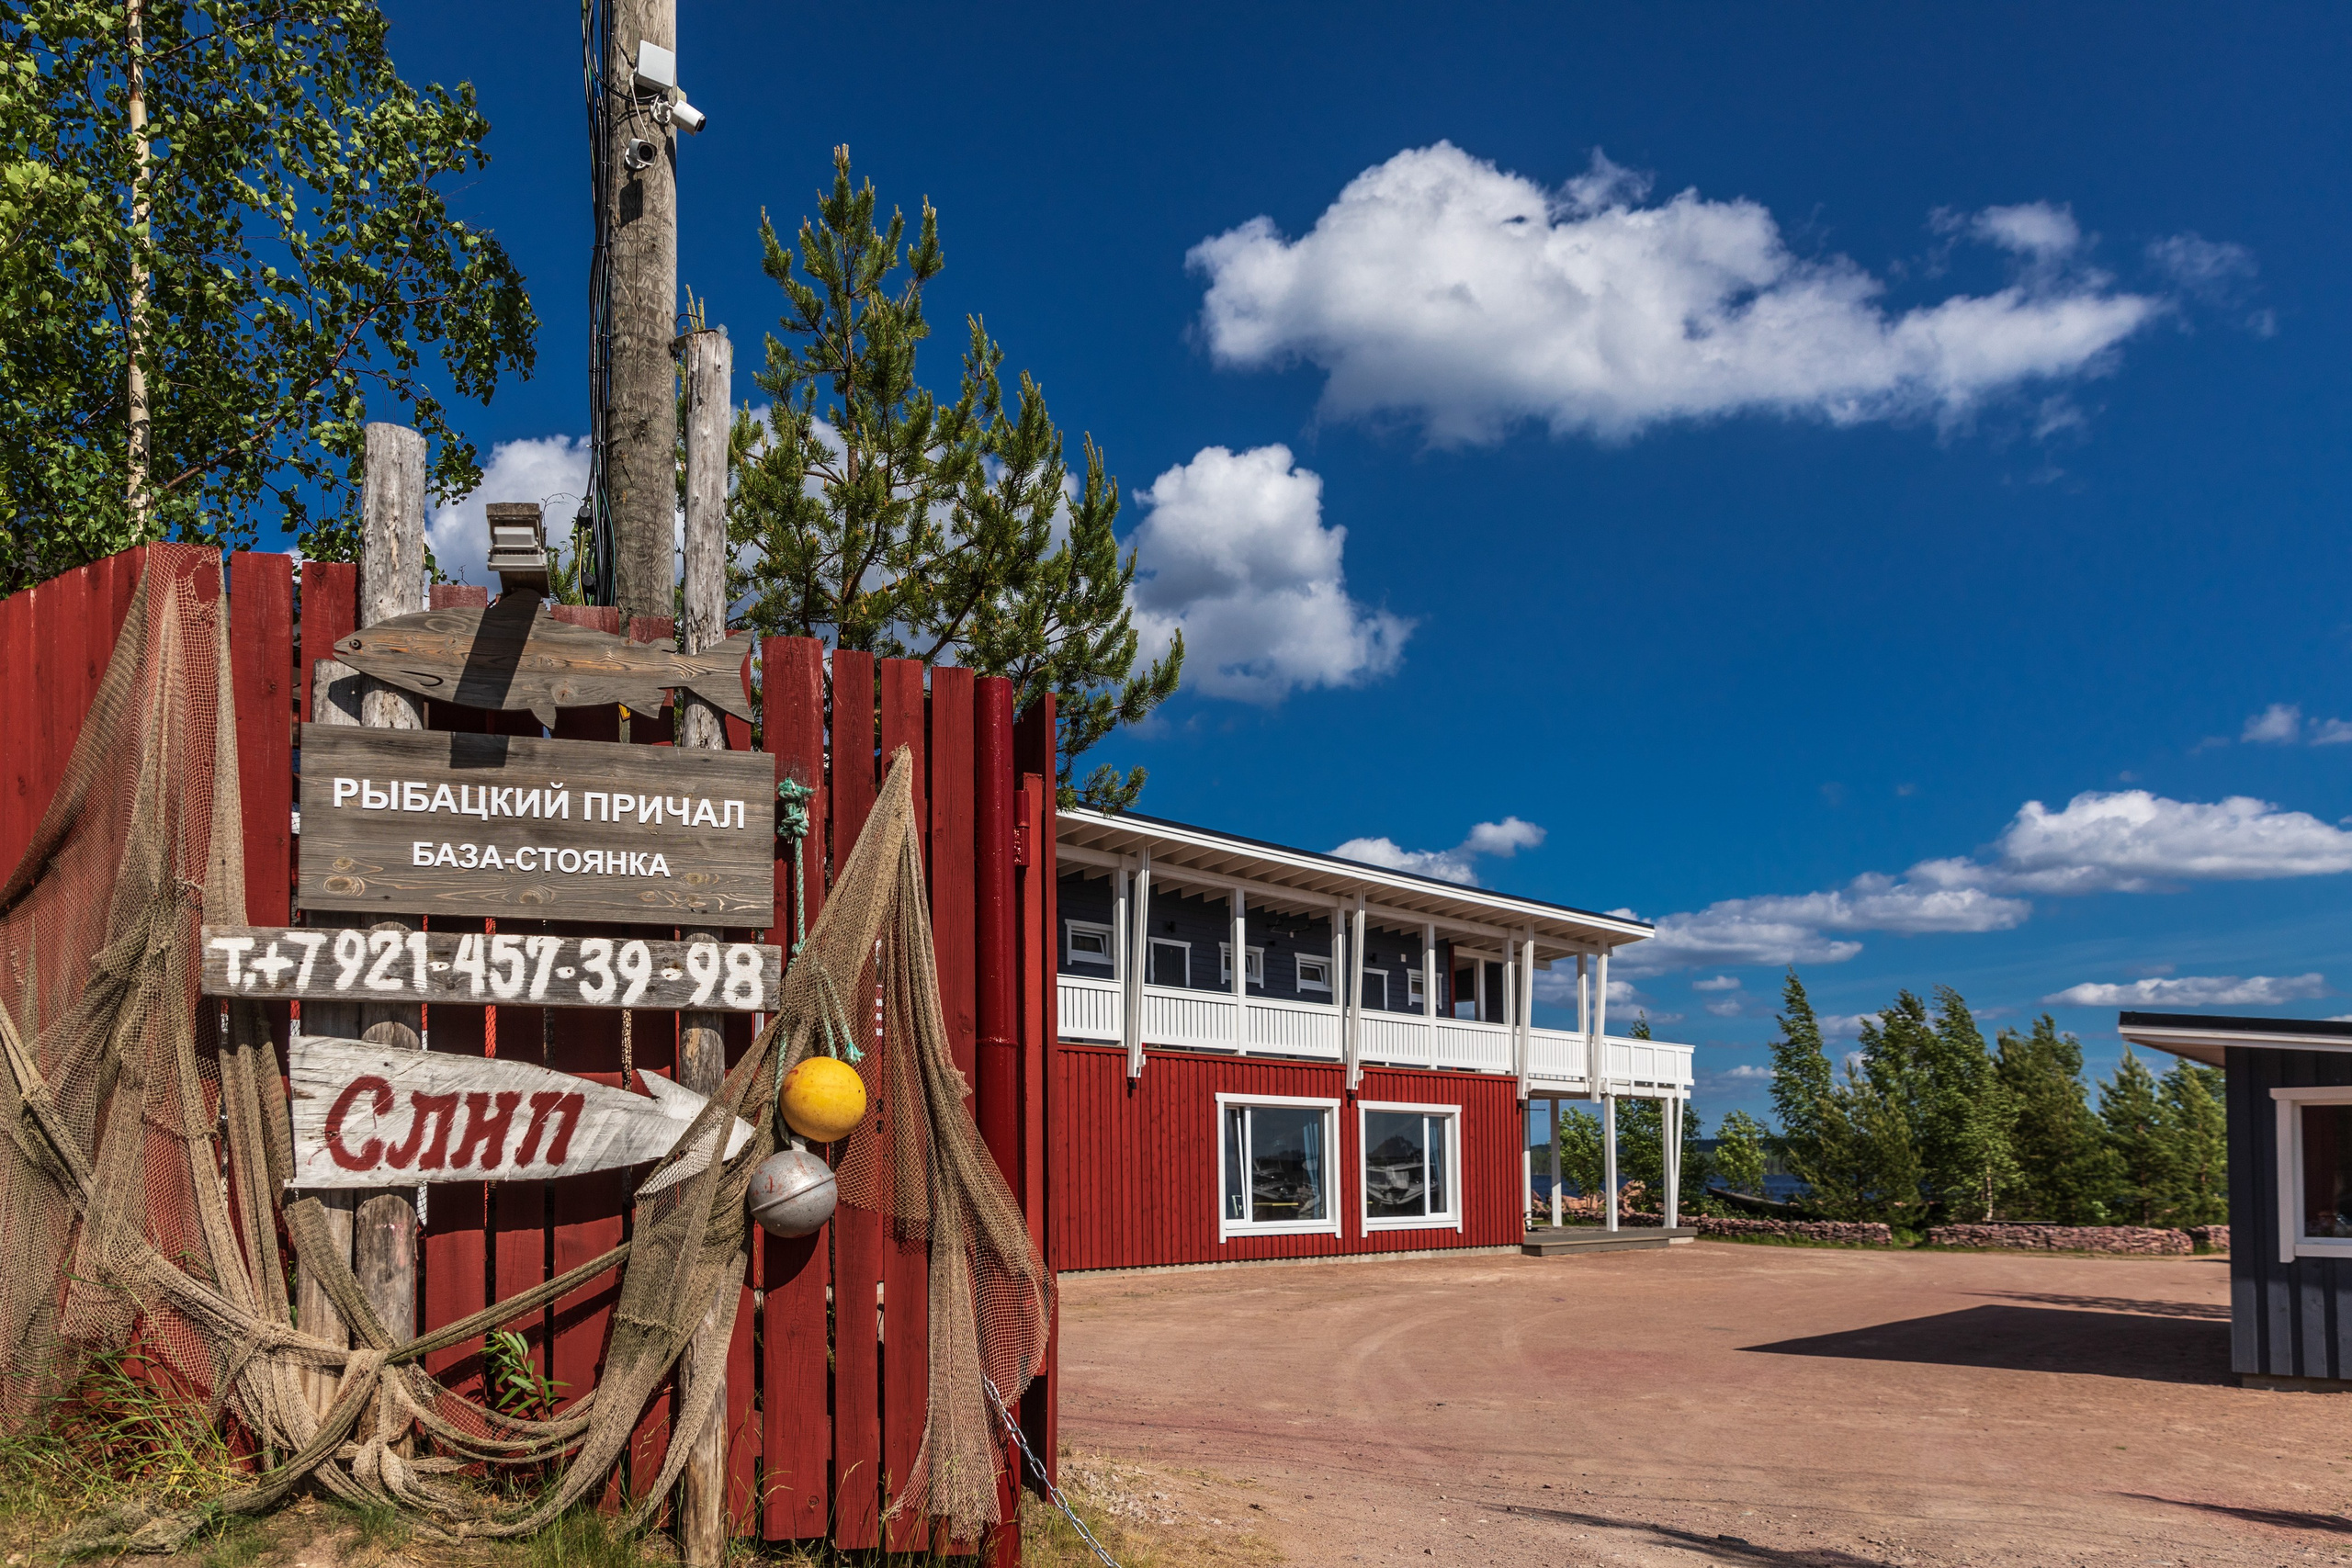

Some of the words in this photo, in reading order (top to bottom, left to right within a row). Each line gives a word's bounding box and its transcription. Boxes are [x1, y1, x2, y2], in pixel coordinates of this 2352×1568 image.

[333, 777, 570, 821] РЫБАЦКИЙ
[583, 791, 745, 829] ПРИЧАЛ
[412, 841, 672, 878] БАЗА-СТОЯНКА
